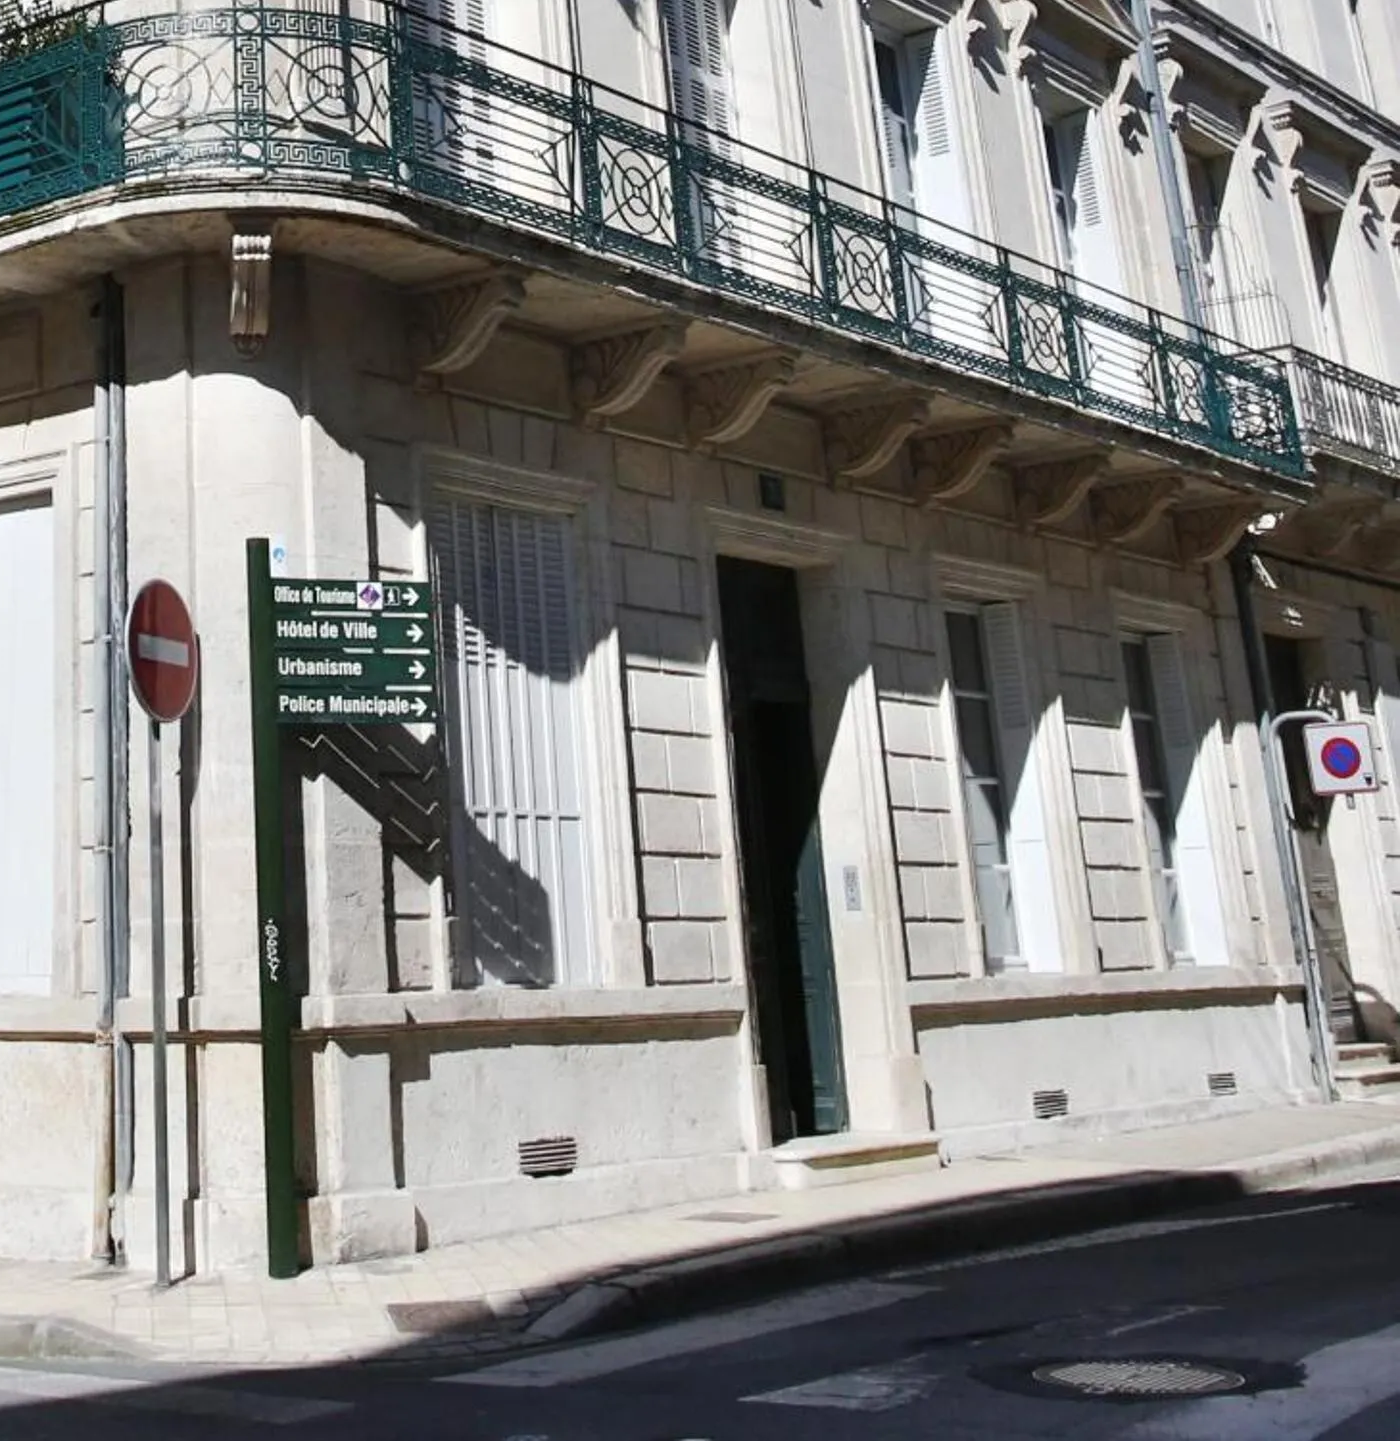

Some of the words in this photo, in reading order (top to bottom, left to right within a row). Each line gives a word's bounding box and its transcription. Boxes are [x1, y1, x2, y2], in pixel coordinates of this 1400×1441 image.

[274, 586, 300, 603] Office
[302, 586, 313, 603] de
[315, 587, 356, 604] Tourisme
[277, 621, 317, 638] Hôtel
[320, 622, 338, 638] de
[343, 622, 377, 639] Ville
[278, 658, 362, 676] Urbanisme
[279, 695, 325, 713] Police
[329, 695, 410, 716] Municipale
